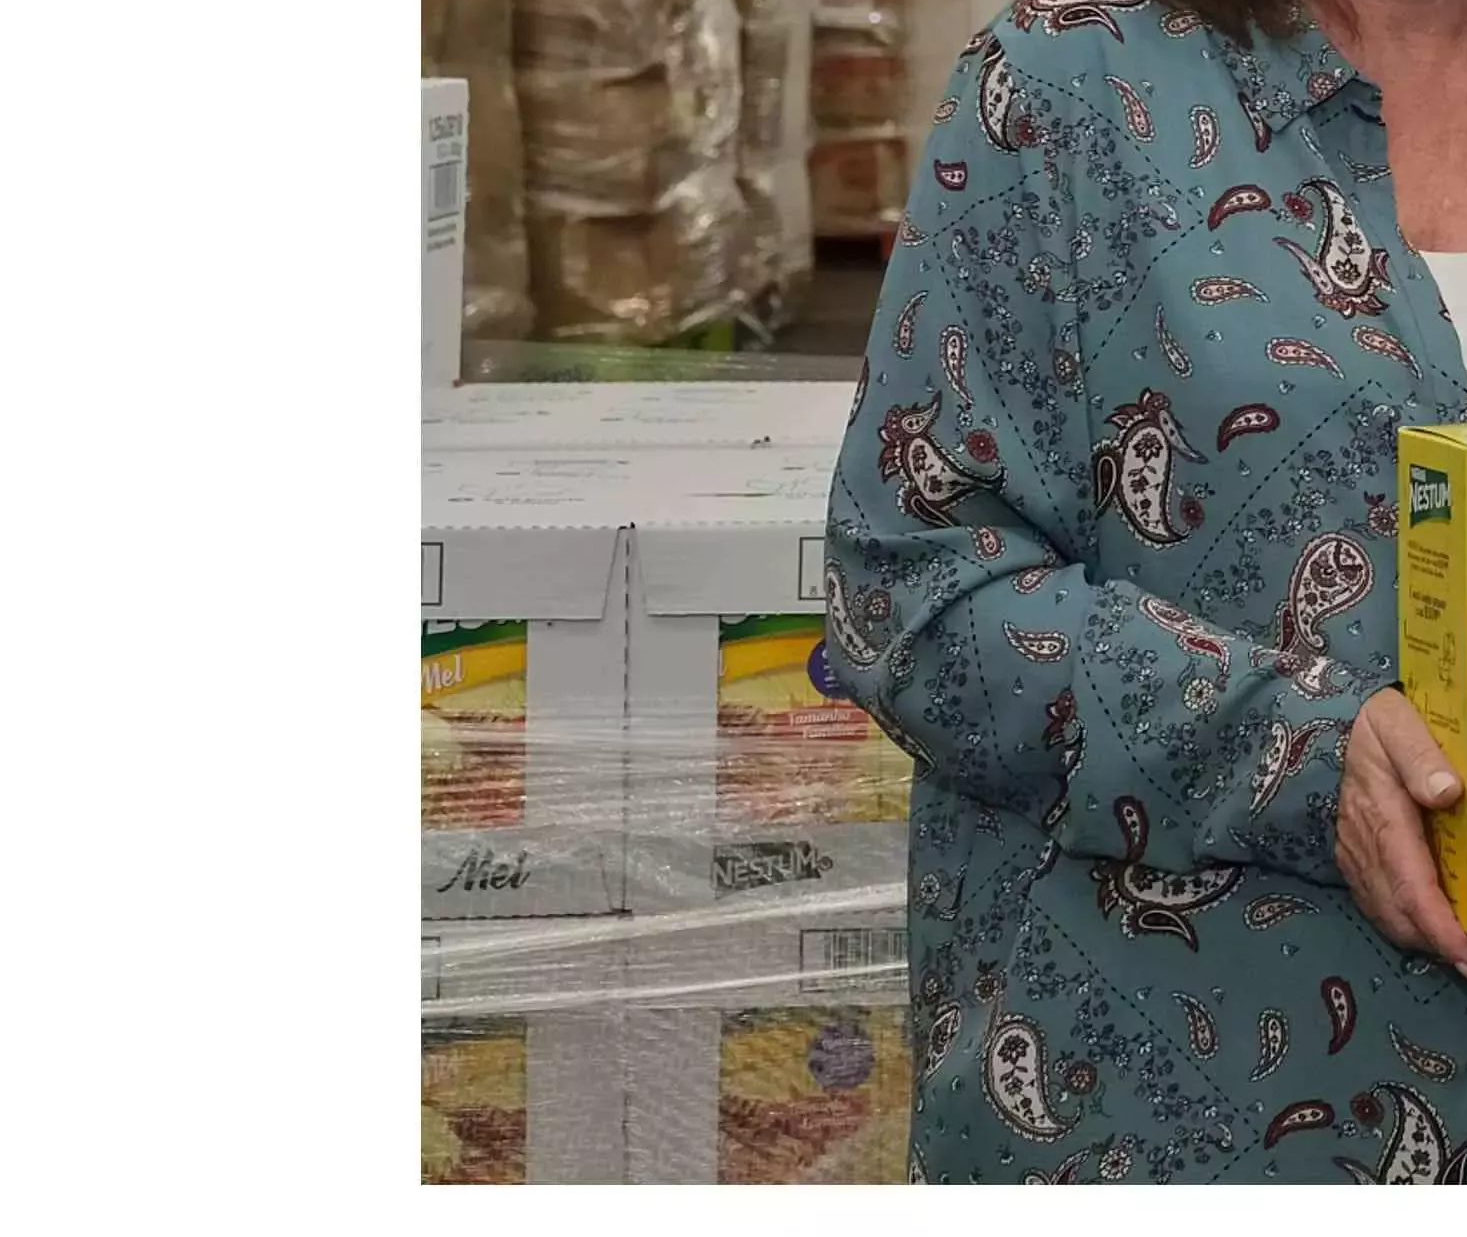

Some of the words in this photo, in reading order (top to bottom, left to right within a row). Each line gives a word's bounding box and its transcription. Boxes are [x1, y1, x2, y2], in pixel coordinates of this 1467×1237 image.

[1409, 480, 1450, 513] NESTUM
[437, 847, 532, 895] Mel
[711, 842, 822, 889] NESTUM
